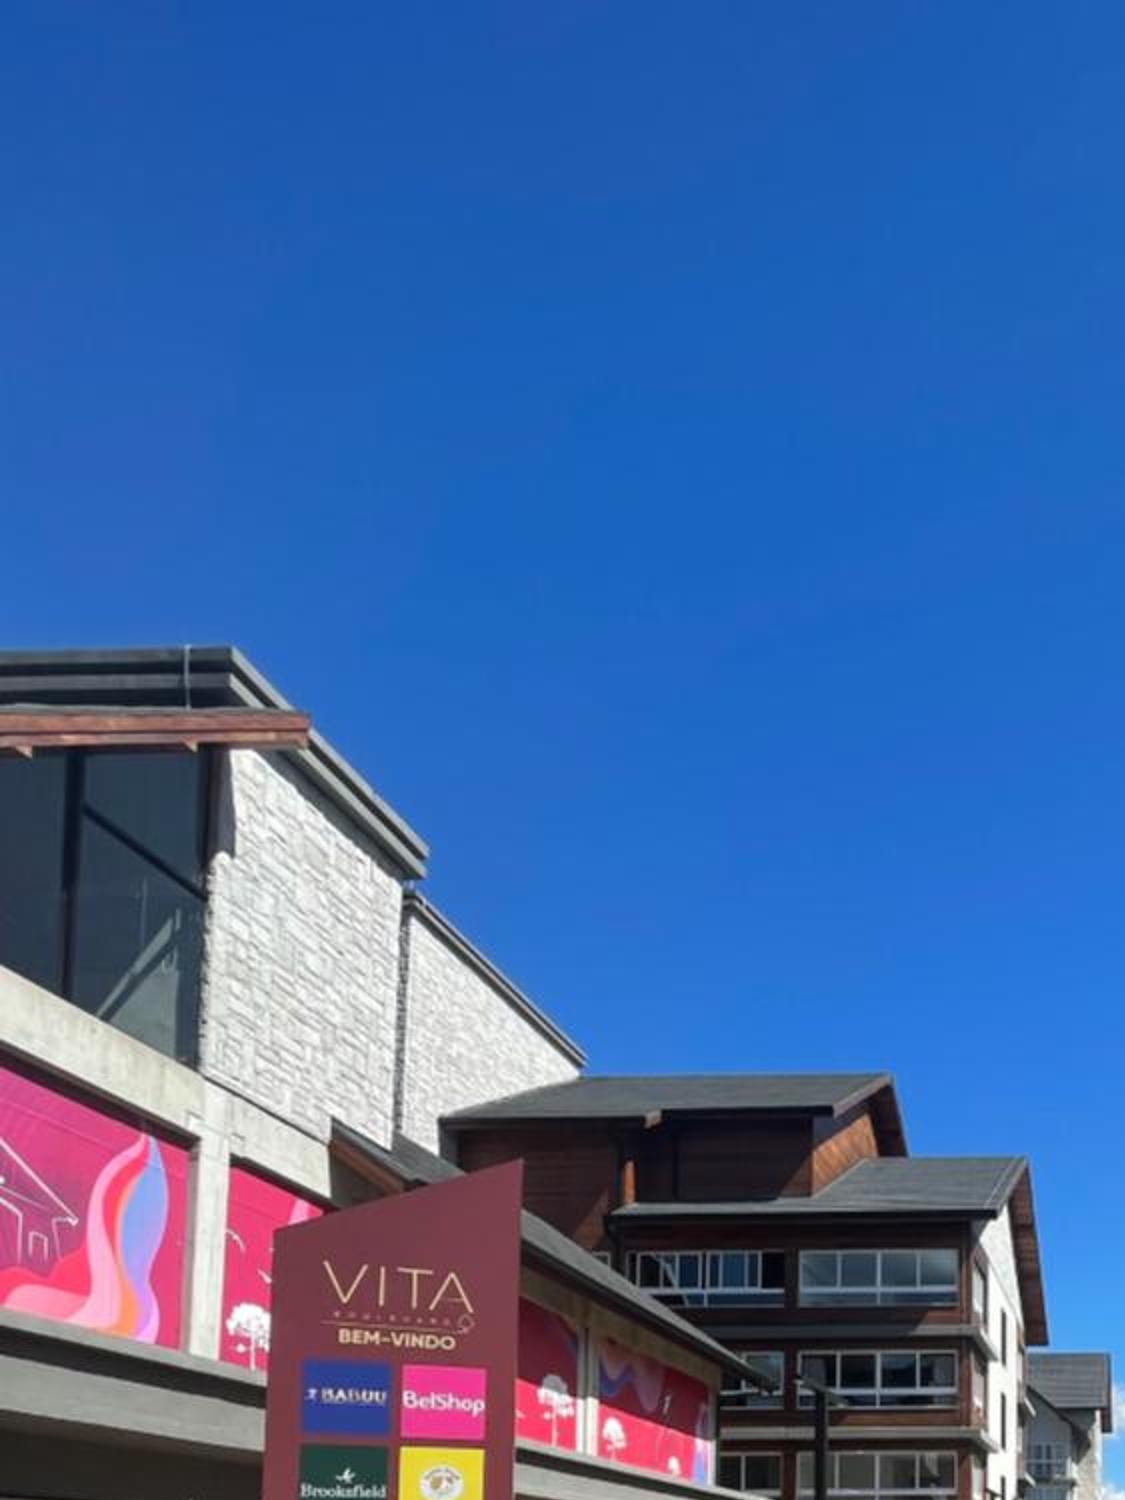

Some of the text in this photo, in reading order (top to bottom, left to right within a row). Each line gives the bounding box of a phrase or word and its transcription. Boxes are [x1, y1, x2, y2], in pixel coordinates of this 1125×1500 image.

[322, 1260, 475, 1313] VITA
[338, 1328, 456, 1350] BEM-VINDO
[403, 1390, 485, 1417] BelShop
[300, 1483, 386, 1499] Brooksfield
